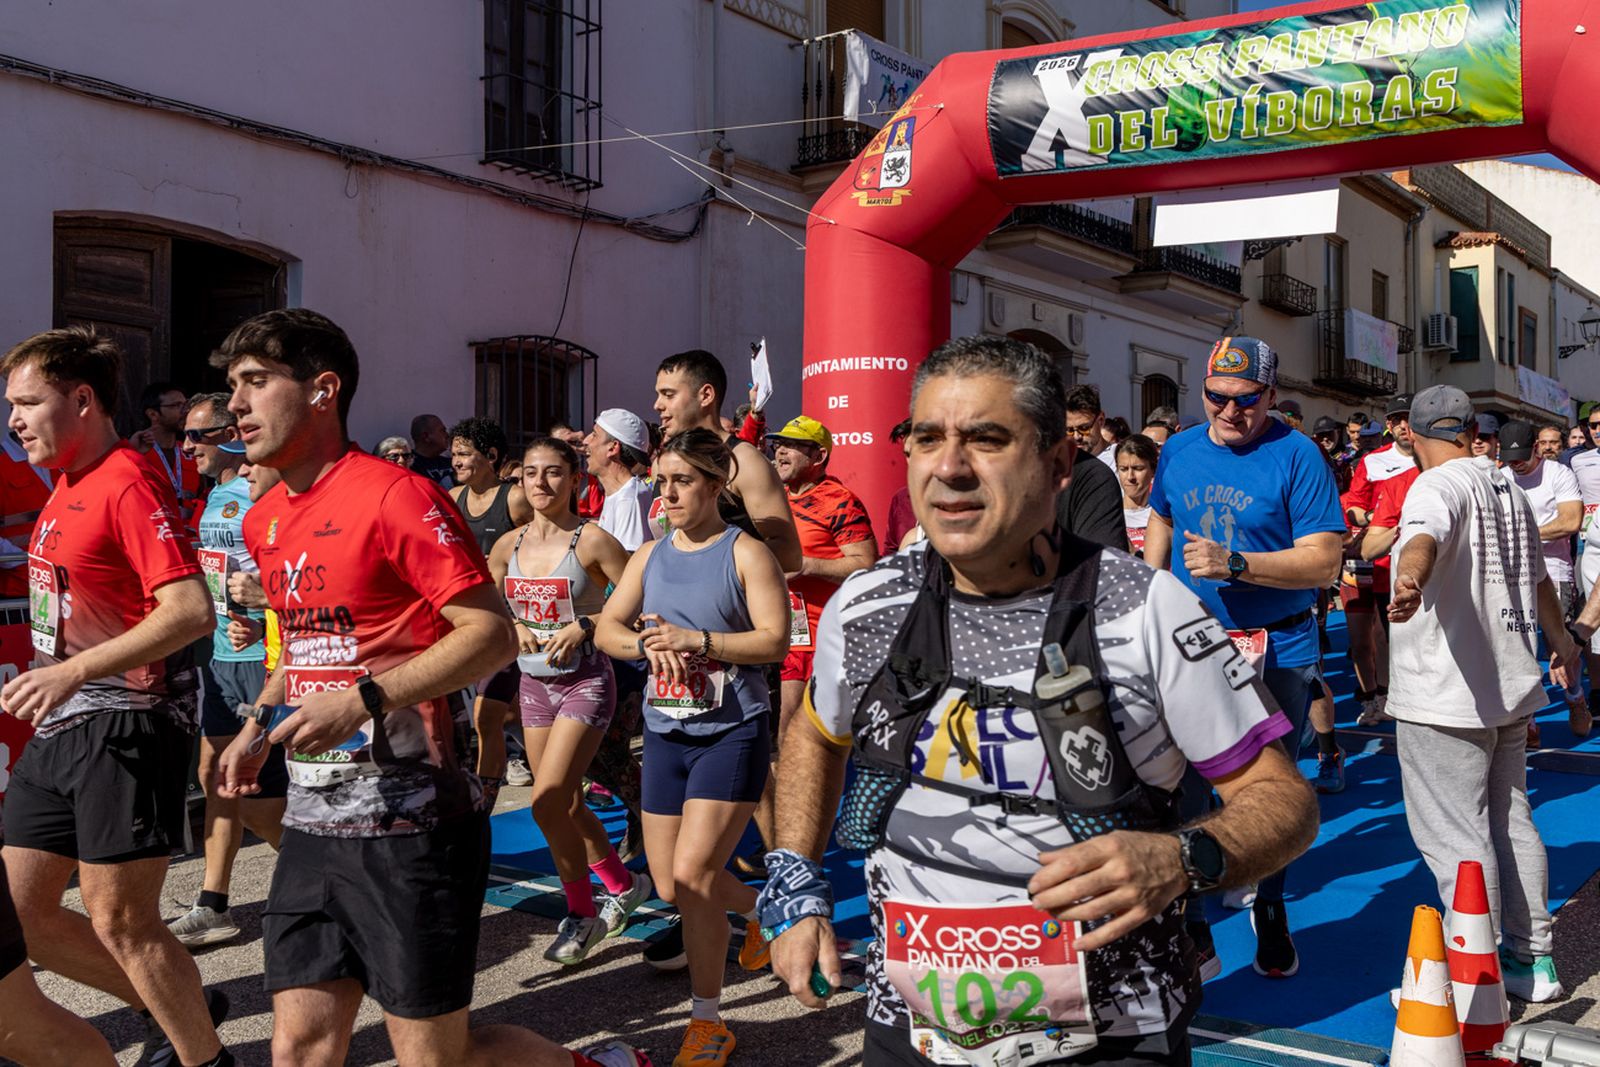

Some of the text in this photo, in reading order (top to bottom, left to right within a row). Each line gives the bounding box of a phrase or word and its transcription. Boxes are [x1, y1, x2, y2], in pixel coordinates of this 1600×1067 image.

[871, 49, 899, 72] CROSS
[1038, 56, 1077, 72] 2026
[1021, 4, 1470, 172] X CROSS PANTANO
[1086, 67, 1459, 155] DEL VÍBORAS
[828, 395, 848, 409] DE
[831, 431, 874, 446] RTOS
[1183, 485, 1253, 512] IX CROSS
[269, 565, 326, 595] CROSS
[514, 581, 558, 595] X CROSS
[517, 600, 561, 623] 734
[289, 674, 350, 698] X CROSS
[903, 911, 932, 948] X
[935, 924, 1042, 952] CROSS
[907, 949, 1045, 975] PANTANO DEL
[917, 970, 1049, 1027] 102
